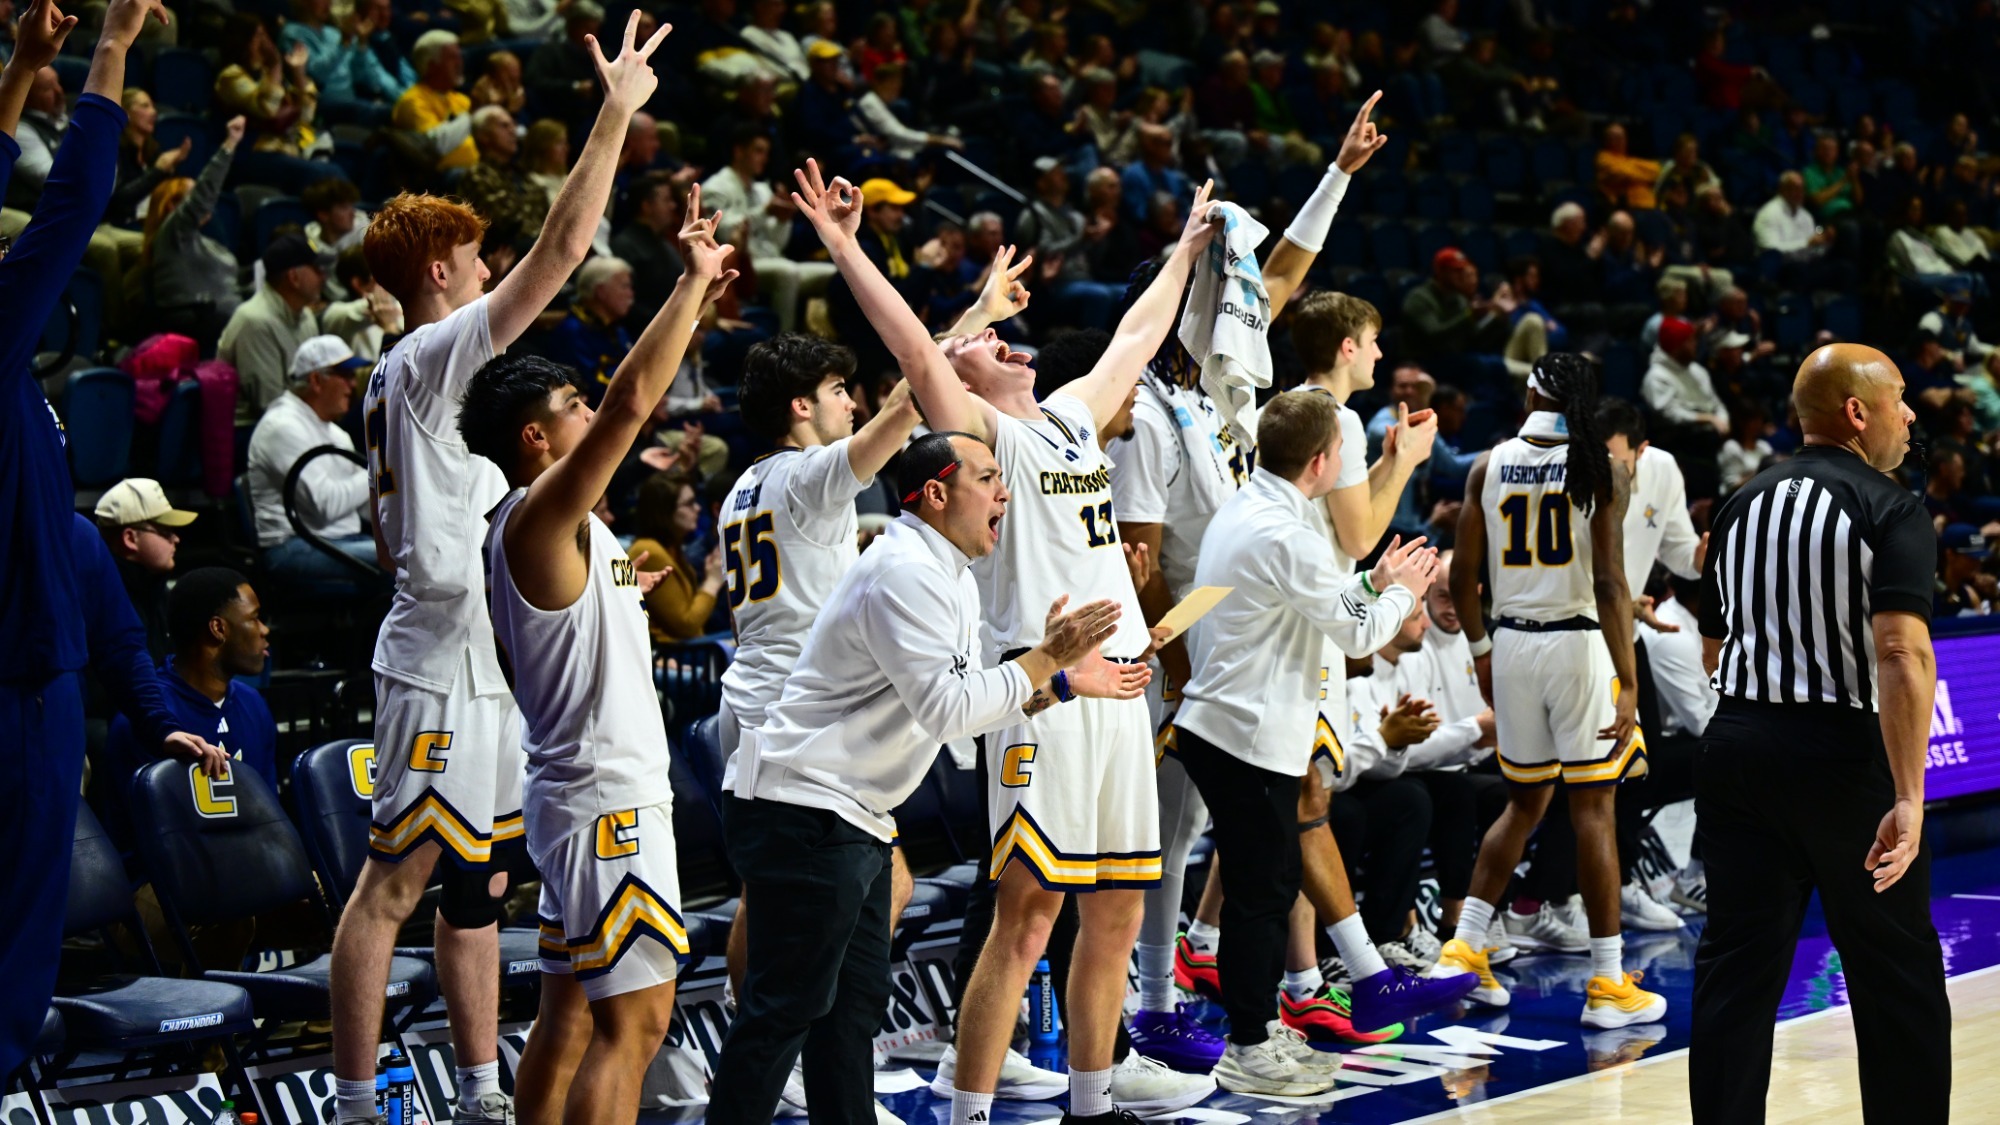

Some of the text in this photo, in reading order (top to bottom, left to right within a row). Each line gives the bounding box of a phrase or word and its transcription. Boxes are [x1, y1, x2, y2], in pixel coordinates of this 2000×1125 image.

[1500, 491, 1573, 567] 10
[724, 510, 782, 610] 55
[408, 731, 453, 773] C
[1000, 743, 1038, 788] C
[594, 808, 639, 860] C
[160, 1014, 222, 1033] CHATTANOOGA
[1041, 973, 1051, 1032] POWERADE
